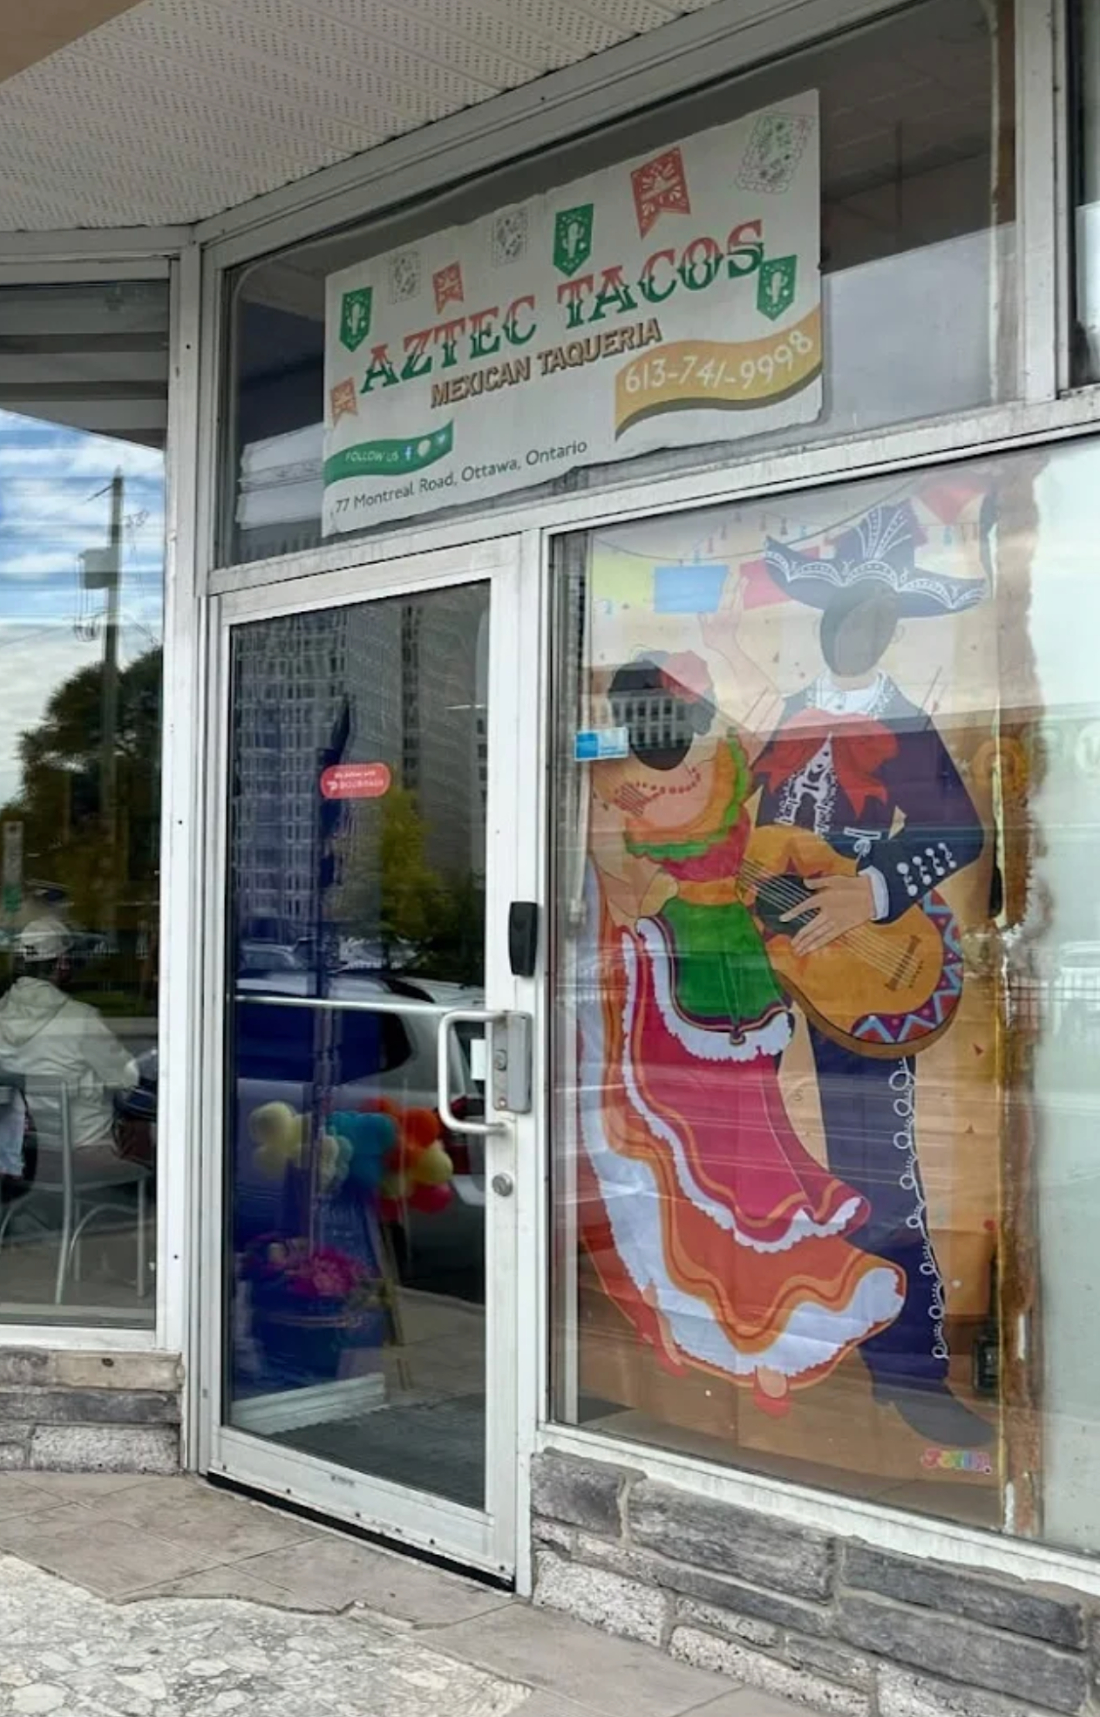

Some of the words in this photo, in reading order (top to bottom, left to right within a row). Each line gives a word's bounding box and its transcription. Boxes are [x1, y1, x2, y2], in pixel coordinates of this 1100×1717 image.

[360, 295, 537, 394] AZTEC
[557, 219, 765, 330] TACOS
[431, 356, 532, 409] MEXICAN
[536, 317, 663, 376] TAQUERIA
[625, 330, 814, 394] 613-741-9998
[335, 497, 351, 513] 77
[353, 484, 414, 509] Montreal
[419, 473, 458, 493] Road,
[461, 459, 521, 483] Ottawa,
[525, 440, 588, 467] Ontario
[345, 450, 384, 463] FOLLOW
